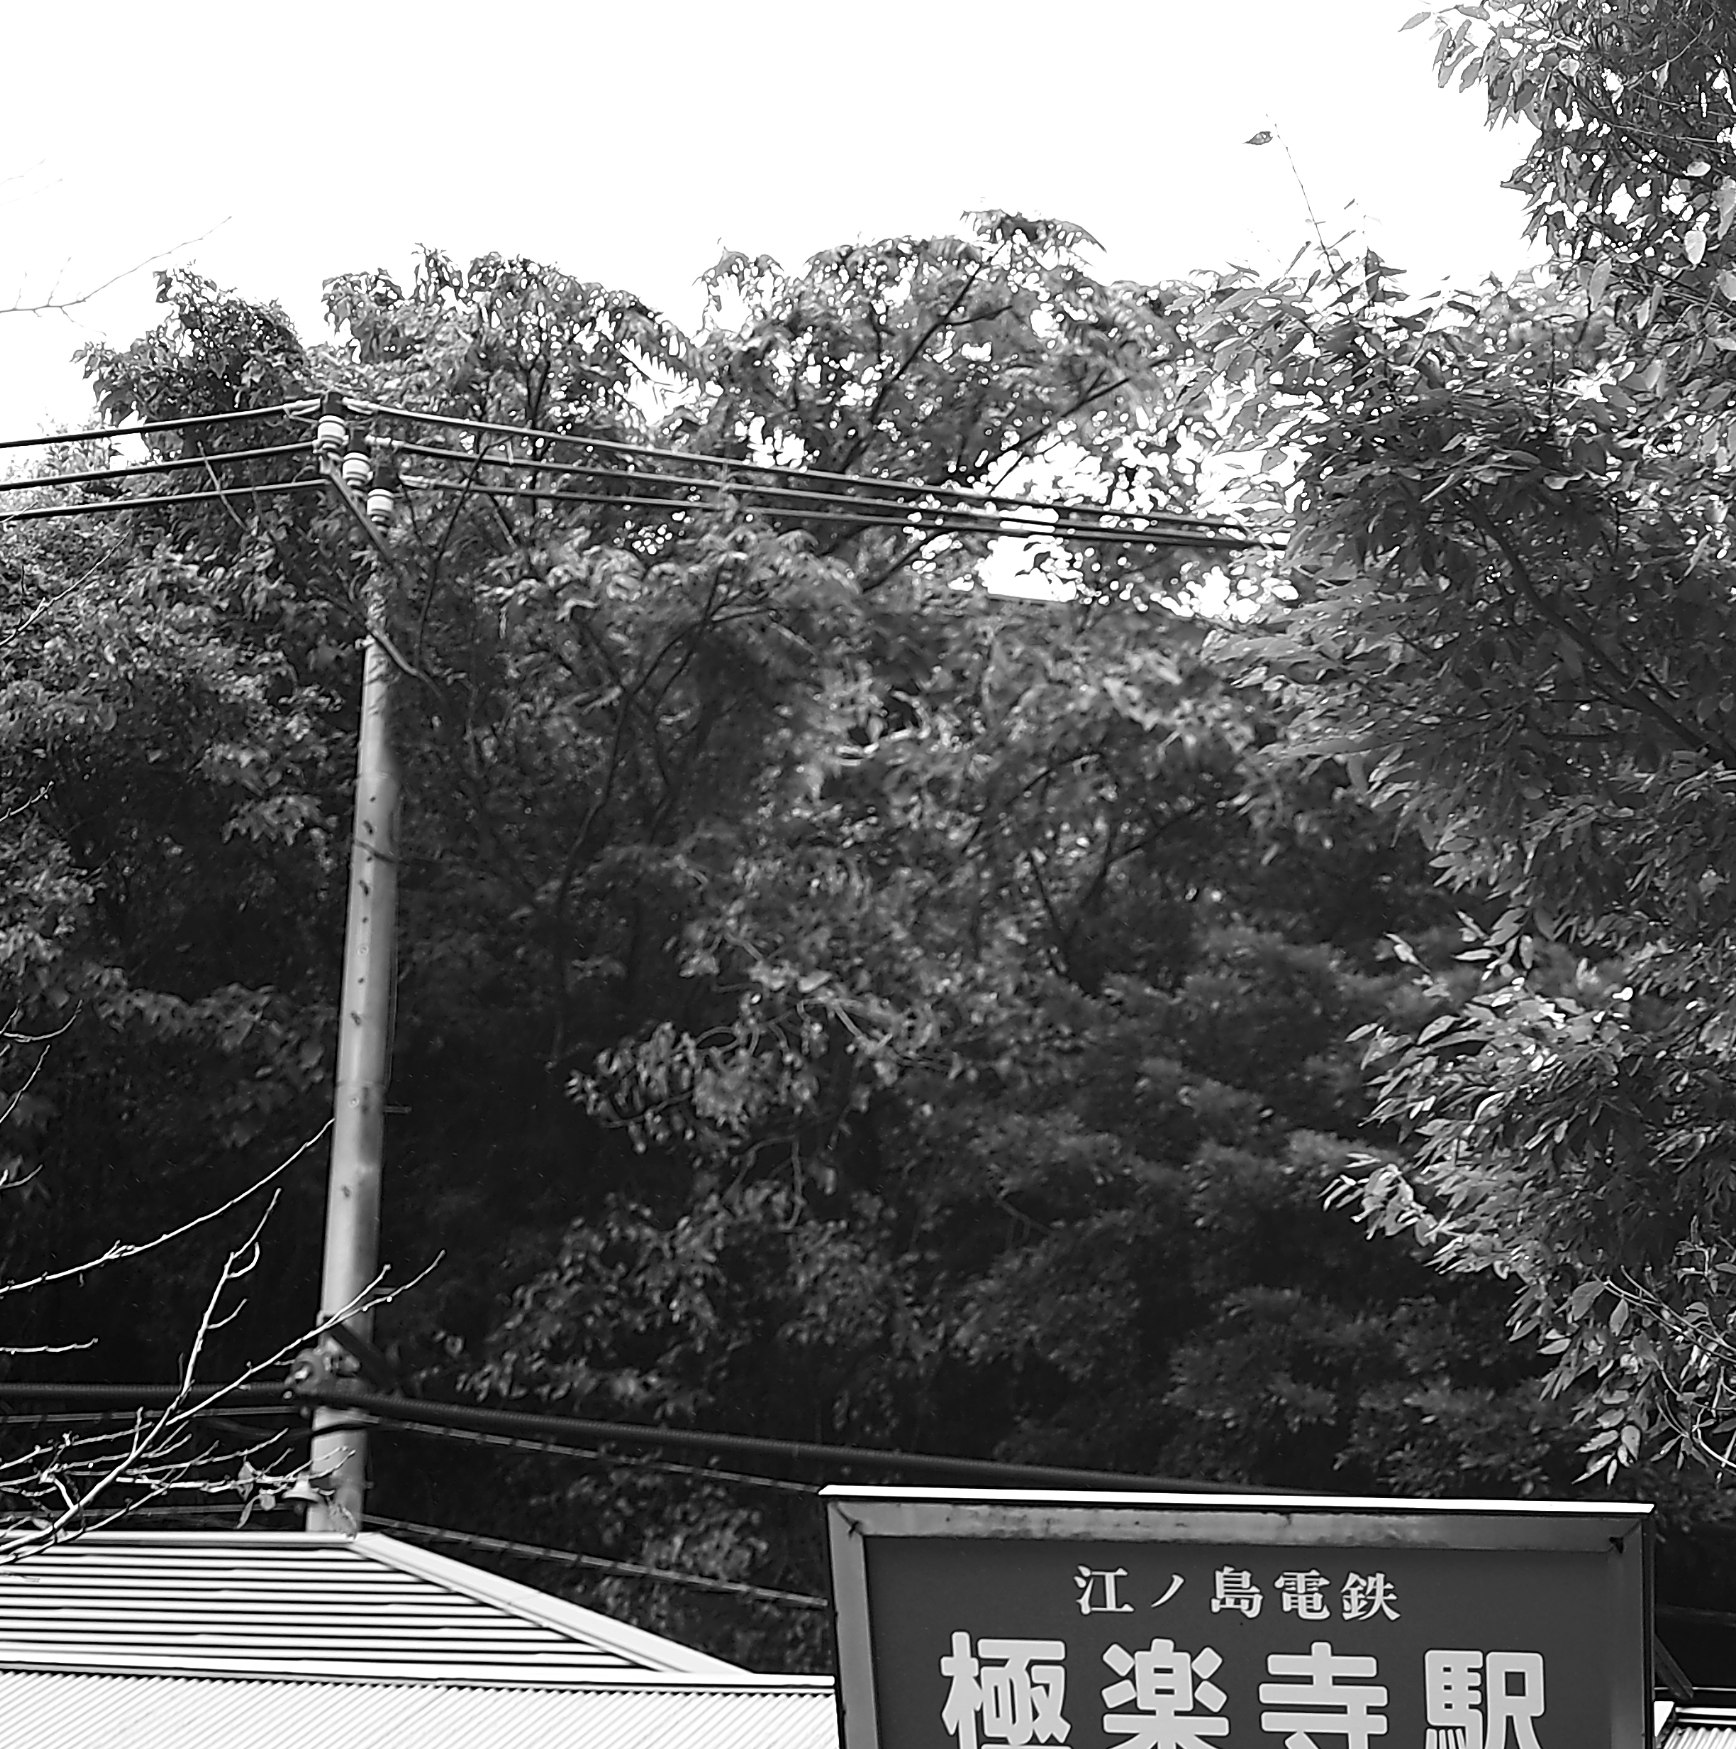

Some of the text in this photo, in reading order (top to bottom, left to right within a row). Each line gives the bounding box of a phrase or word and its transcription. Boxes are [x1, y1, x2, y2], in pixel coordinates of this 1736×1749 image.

[1074, 1565, 1402, 1623] 江ノ島電鉄
